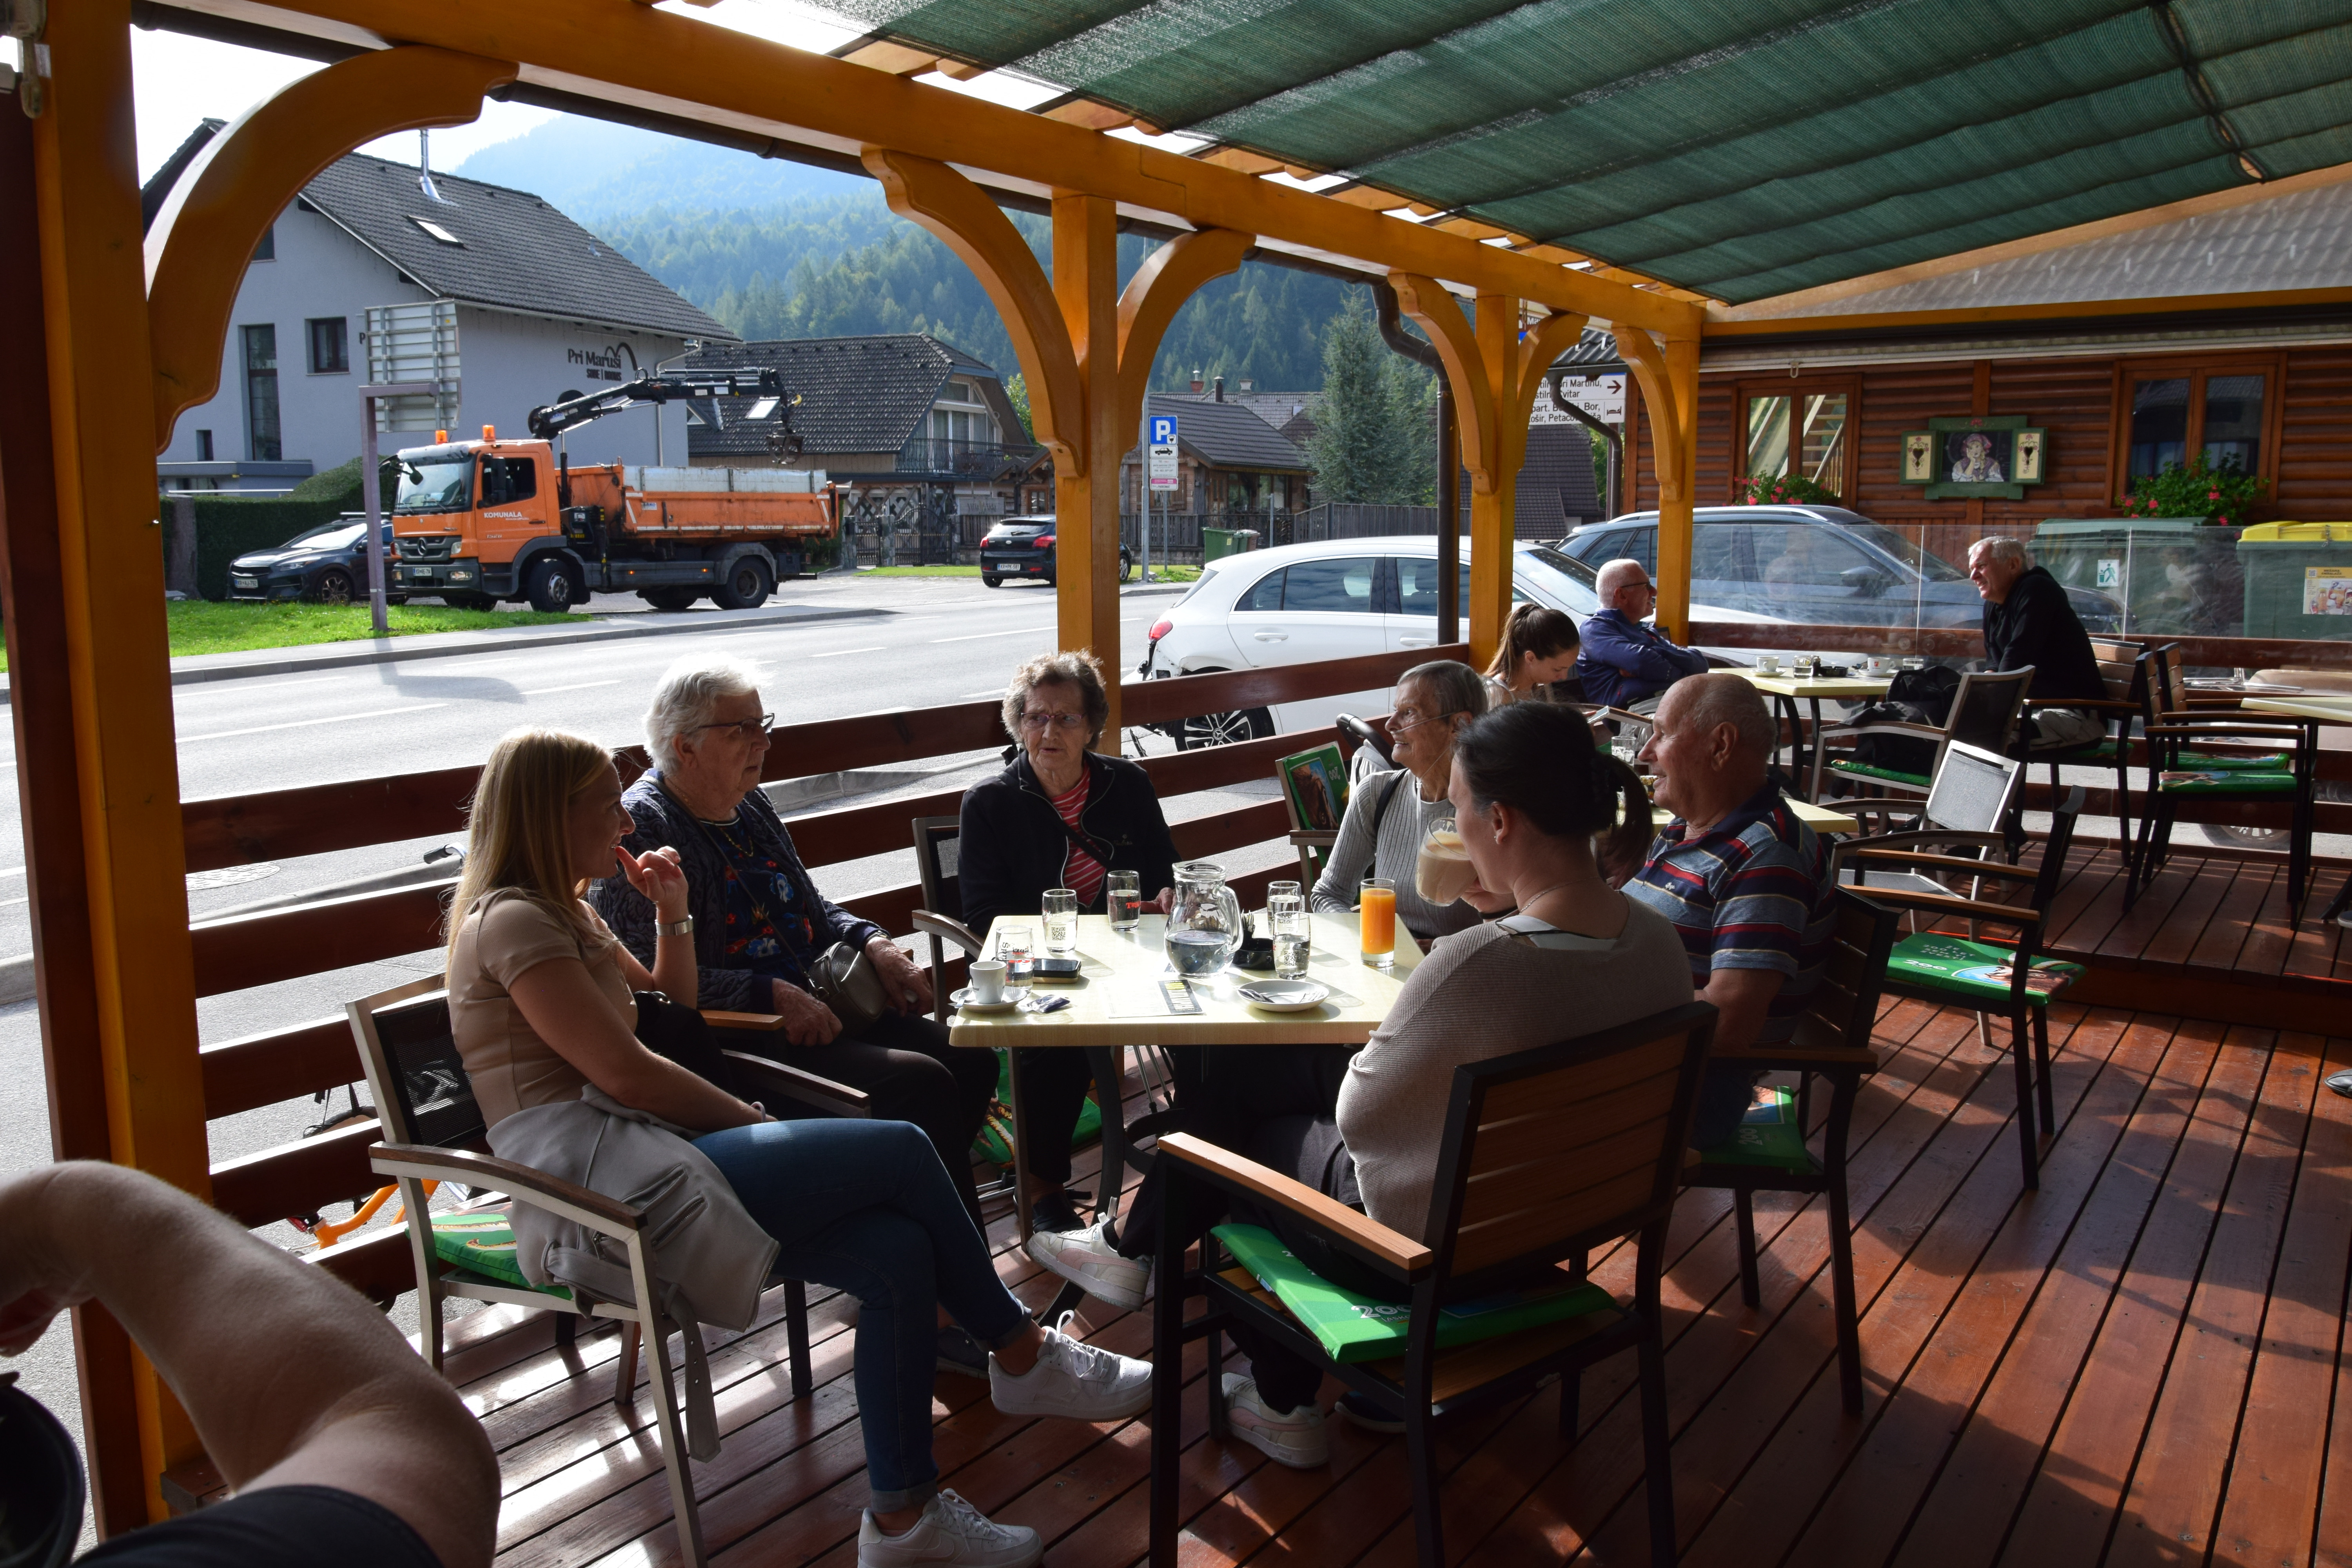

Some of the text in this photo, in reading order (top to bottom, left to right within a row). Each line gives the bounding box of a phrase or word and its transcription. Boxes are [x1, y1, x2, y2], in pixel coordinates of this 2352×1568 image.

[568, 348, 583, 365] Pri
[1584, 402, 1600, 412] Bor,
[1530, 415, 1546, 423] ošir,
[1156, 420, 1170, 441] P
[1328, 766, 1341, 780] 200
[1902, 960, 1948, 970] 200
[1738, 1128, 1763, 1145] 200
